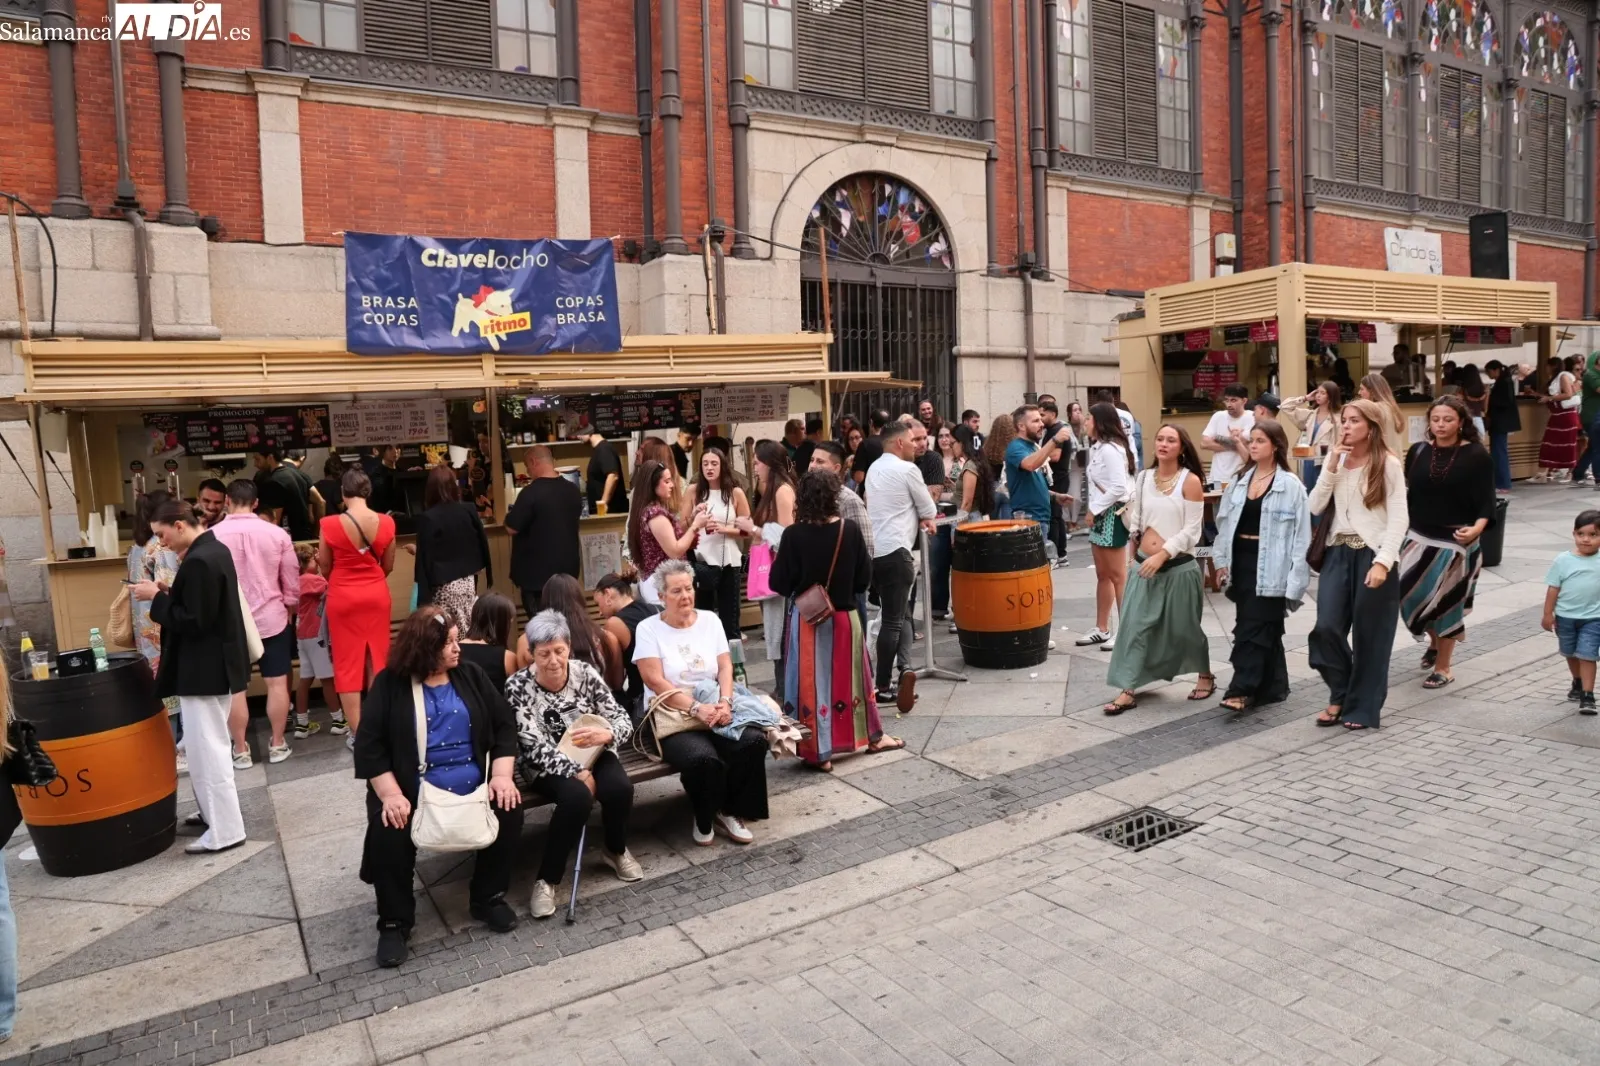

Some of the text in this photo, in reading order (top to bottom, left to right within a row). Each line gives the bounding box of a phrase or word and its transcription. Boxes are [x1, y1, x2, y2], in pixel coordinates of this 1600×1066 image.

[420, 248, 549, 269] Clavelocho
[362, 295, 418, 309] BRASA
[556, 295, 604, 309] COPAS
[363, 312, 419, 326] COPAS
[557, 311, 606, 325] BRASA
[483, 317, 527, 335] ritmo
[208, 408, 265, 417] PROMOCIONES
[333, 420, 359, 428] CANALLA
[408, 427, 429, 435] 1906
